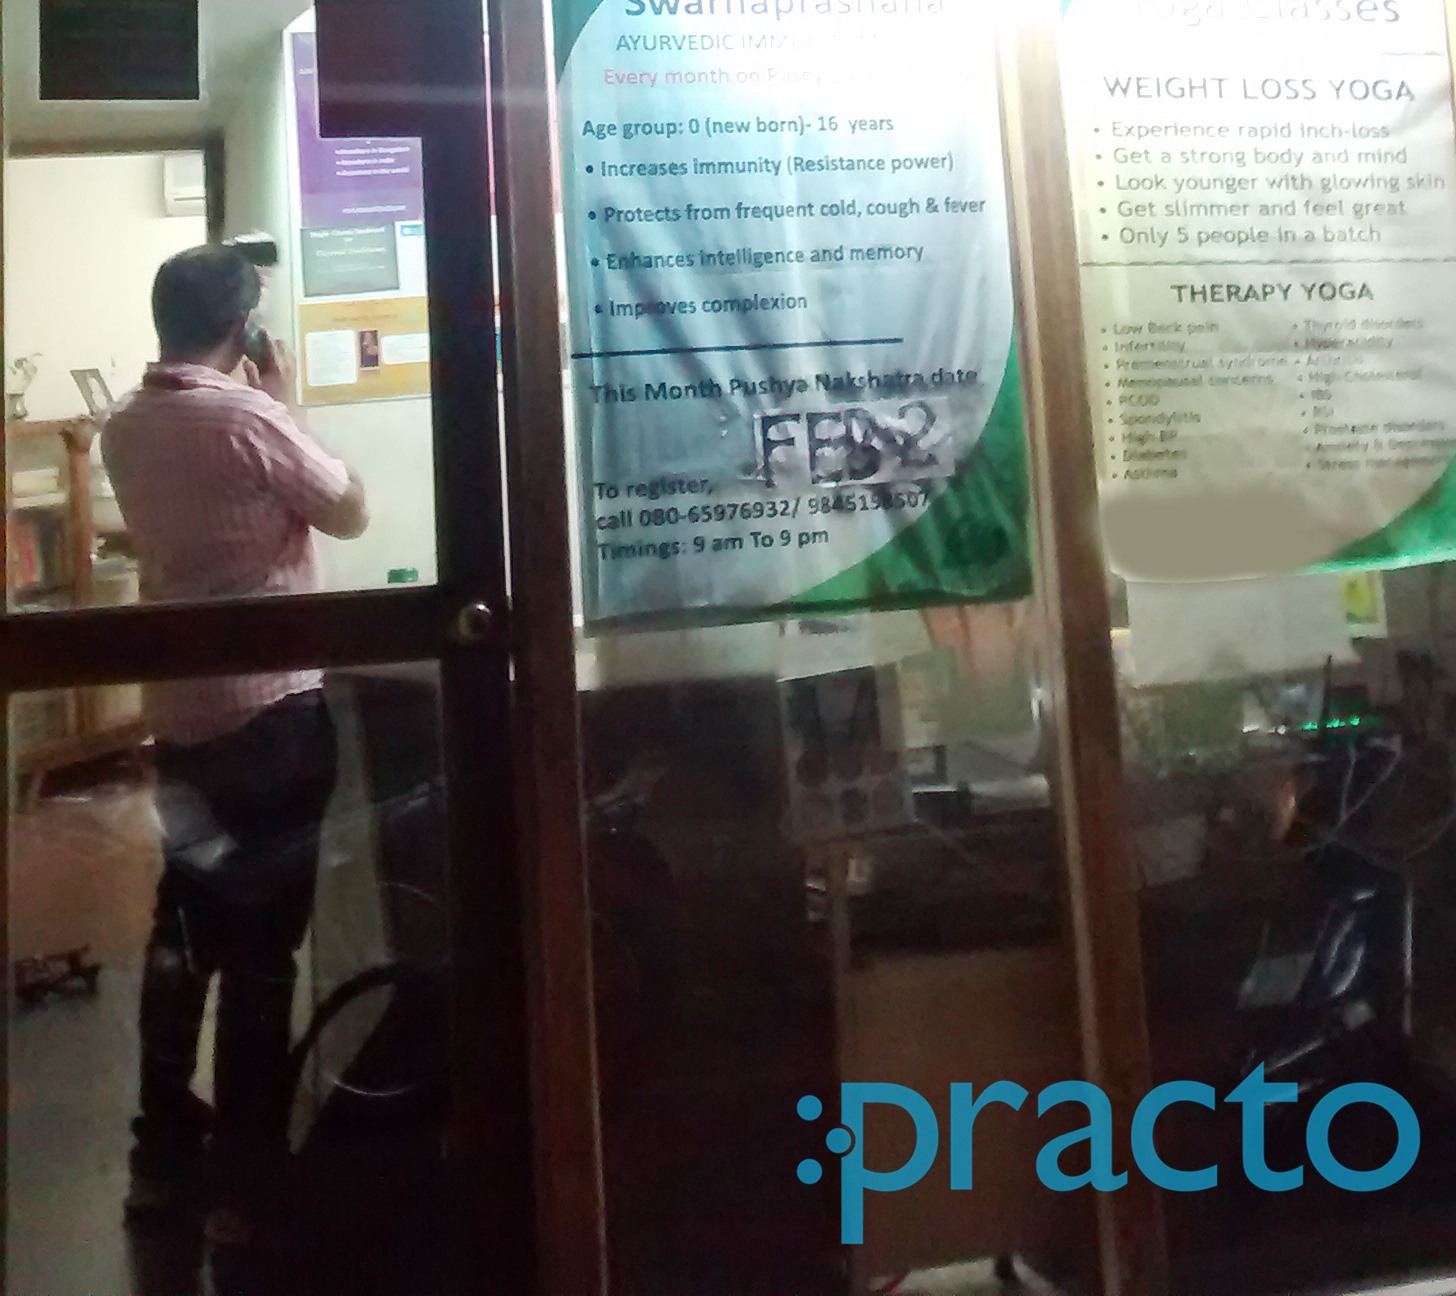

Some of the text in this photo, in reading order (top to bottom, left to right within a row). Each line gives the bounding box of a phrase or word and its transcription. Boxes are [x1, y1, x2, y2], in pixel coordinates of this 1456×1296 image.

[616, 34, 735, 52] AYURVEDIC
[604, 69, 658, 88] Every
[664, 67, 730, 85] month
[736, 70, 761, 84] on
[1104, 77, 1417, 103] WEIGHT LOSS YOGA
[582, 119, 617, 138] Age
[623, 118, 684, 139] group:
[705, 117, 751, 137] (new
[818, 116, 838, 132] 16
[848, 116, 894, 135] years
[1111, 121, 1392, 142] Experience rapid inch-loss
[601, 151, 955, 178] Increases immunity (Resistance power)
[1113, 147, 1409, 168] Get a strong body and mind
[1115, 173, 1446, 194] Look younger with glowing skin
[604, 196, 987, 224] Protects from frequent cold, cough & fever
[1117, 199, 1408, 219] Get slimmer and feel great
[1119, 225, 1382, 247] Only 5 people in a batch
[606, 244, 925, 271] Enhances intelligence and memory
[1171, 281, 1375, 304] THERAPY YOGA
[701, 292, 808, 316] complexion
[591, 383, 637, 403] This
[645, 379, 722, 403] Month
[729, 377, 808, 400] Pushya
[929, 367, 979, 386] date
[595, 482, 619, 500] To
[597, 508, 632, 530] call
[598, 529, 829, 561] Timings: 9 am To 9 pm
